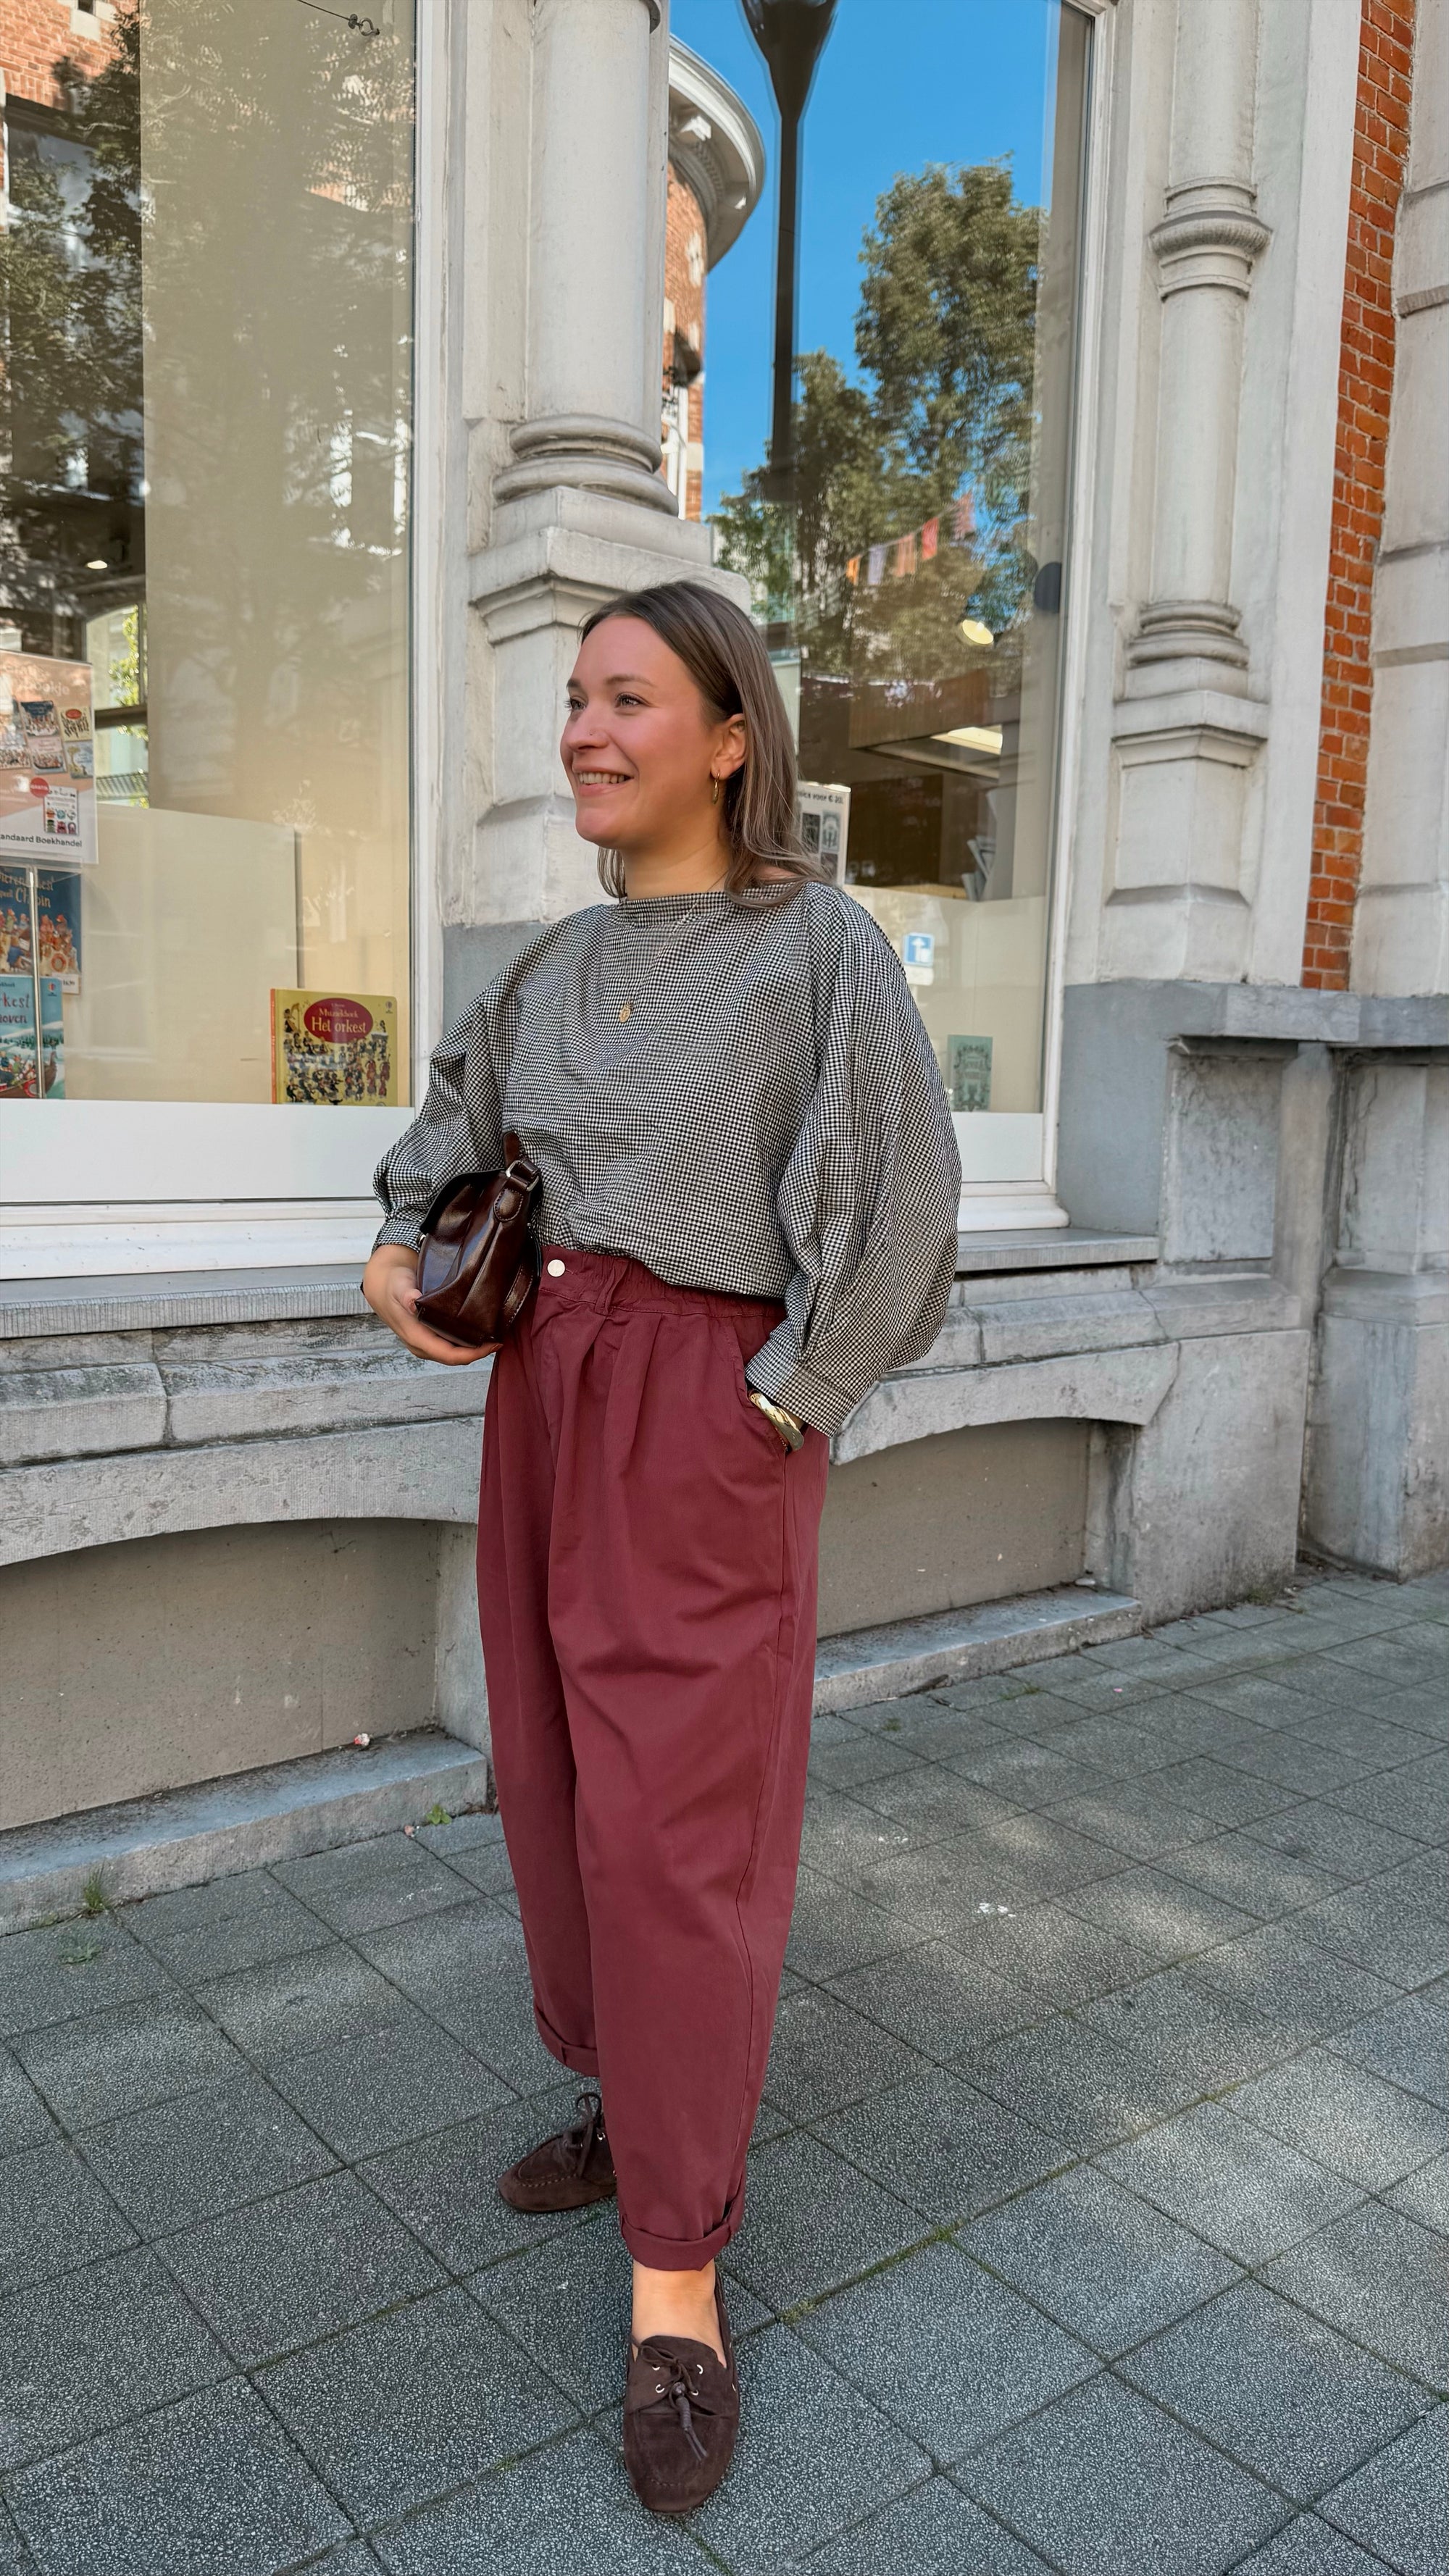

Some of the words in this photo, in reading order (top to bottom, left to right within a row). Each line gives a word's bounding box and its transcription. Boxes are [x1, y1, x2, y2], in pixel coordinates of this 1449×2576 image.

[0, 832, 34, 842] andaard
[36, 835, 82, 847] Boekhandel
[0, 992, 30, 1008] kest
[312, 1016, 330, 1032] Het
[335, 1019, 366, 1034] orkest
